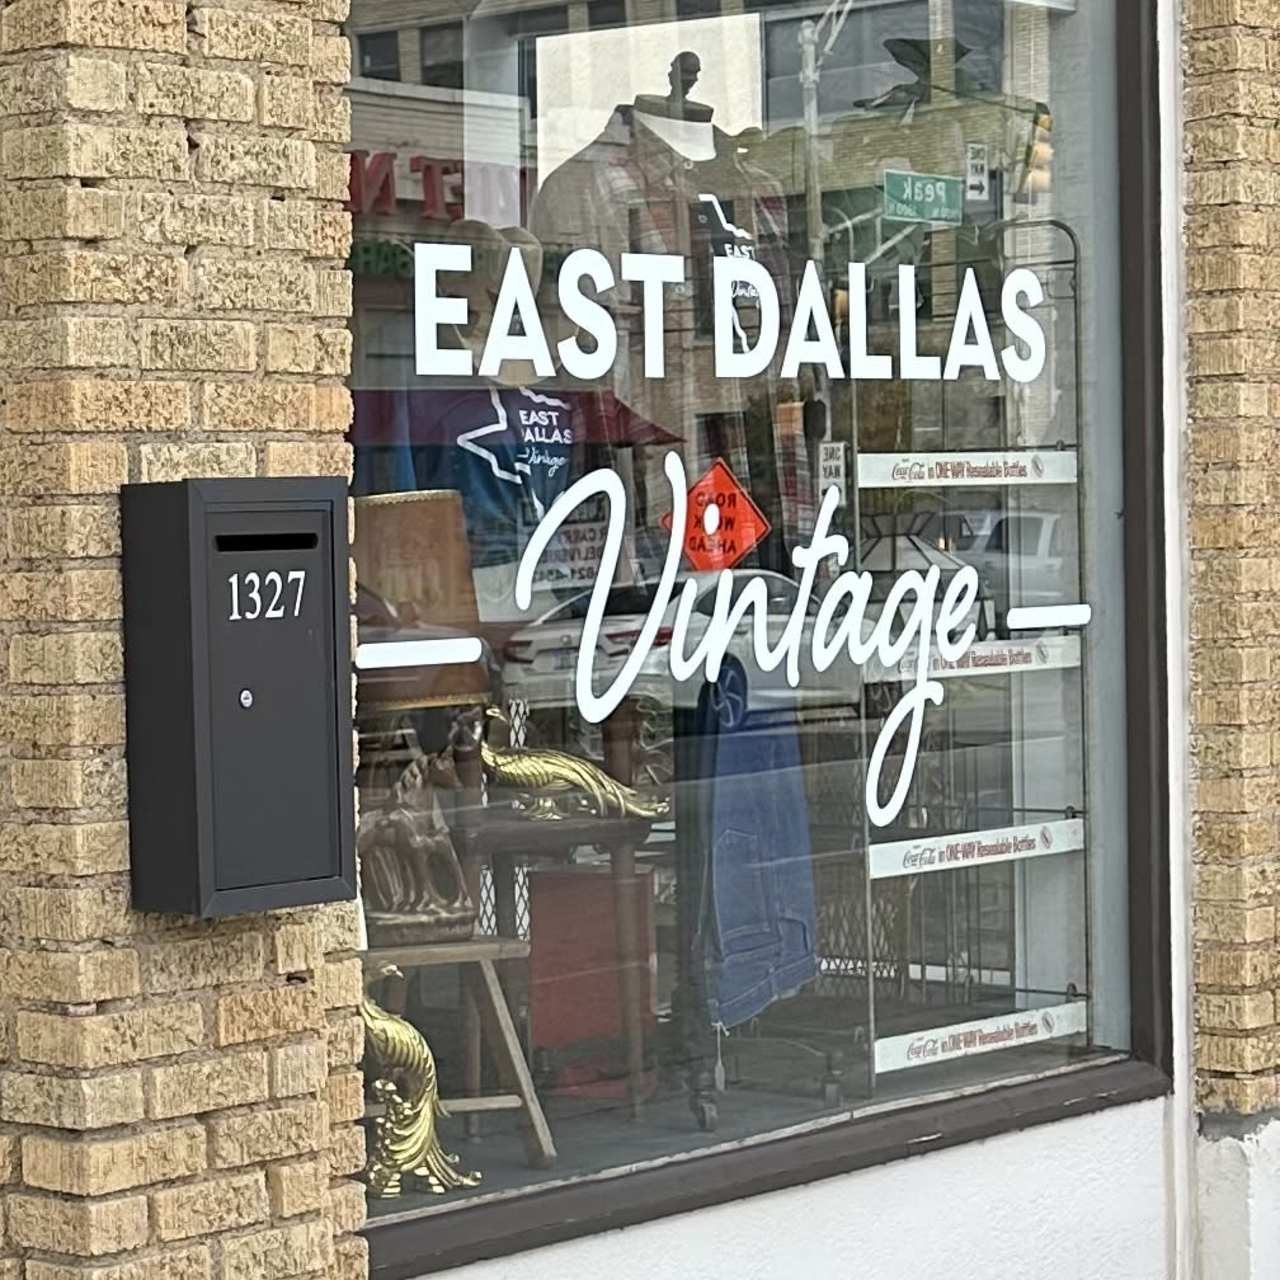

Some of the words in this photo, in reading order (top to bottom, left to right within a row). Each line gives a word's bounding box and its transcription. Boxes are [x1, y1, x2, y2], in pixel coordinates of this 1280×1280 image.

[413, 242, 685, 380] EAST
[714, 255, 1048, 384] DALLAS
[519, 409, 559, 426] EAST
[521, 426, 573, 444] ALLAS
[228, 570, 306, 620] 1327
[515, 451, 980, 828] Vintage
